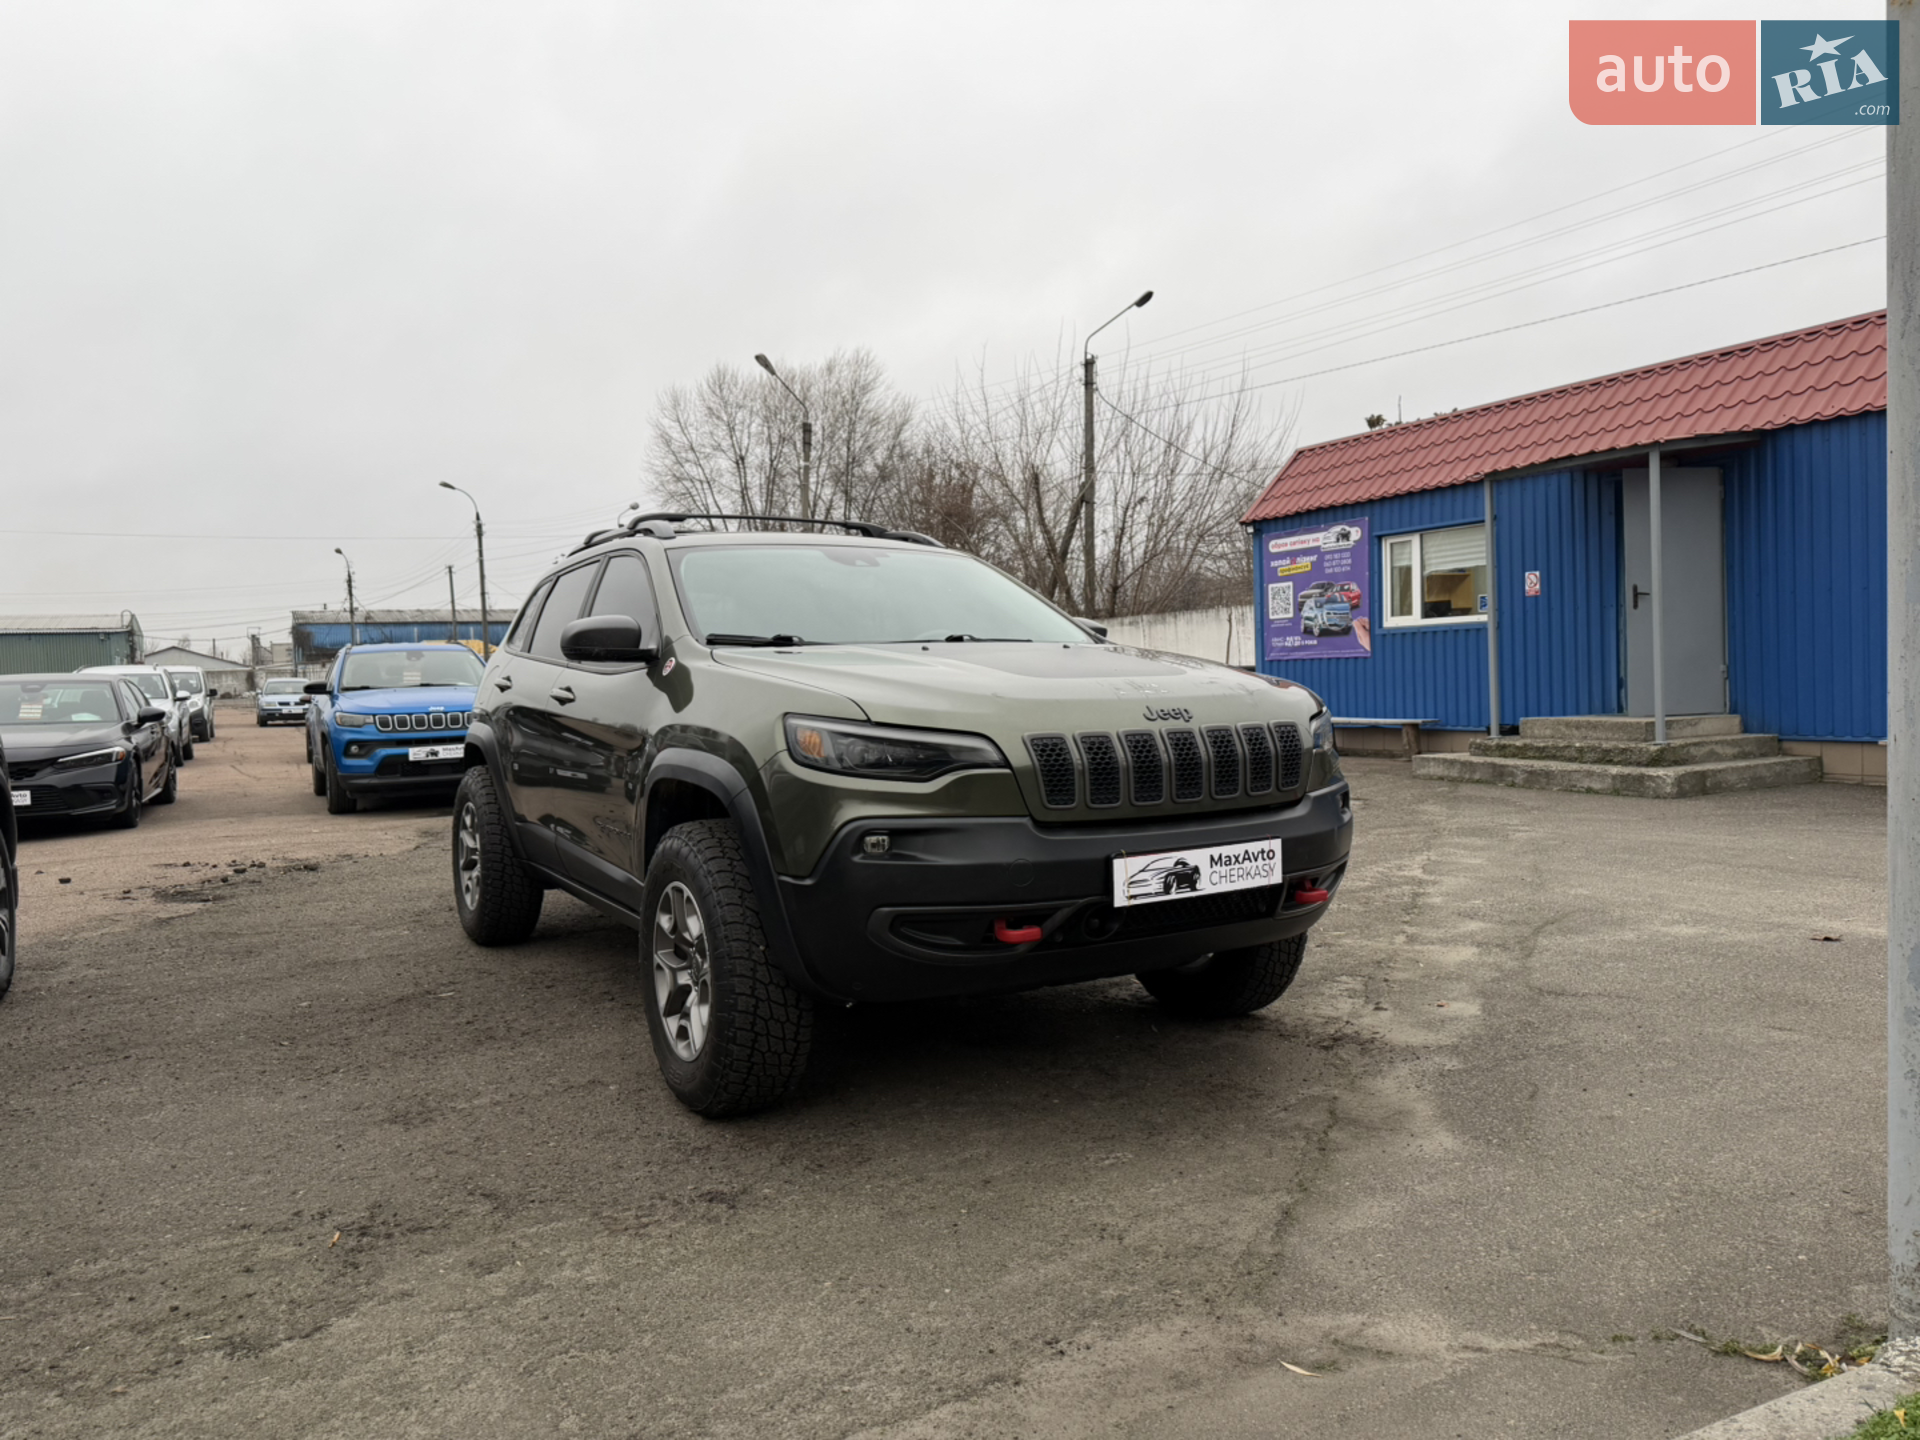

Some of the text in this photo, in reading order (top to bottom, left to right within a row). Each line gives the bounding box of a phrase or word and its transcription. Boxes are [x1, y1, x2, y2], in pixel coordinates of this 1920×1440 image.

[1143, 705, 1193, 723] Jeep
[1209, 848, 1276, 869] MaxAvto
[1209, 862, 1277, 886] CHERKASY
